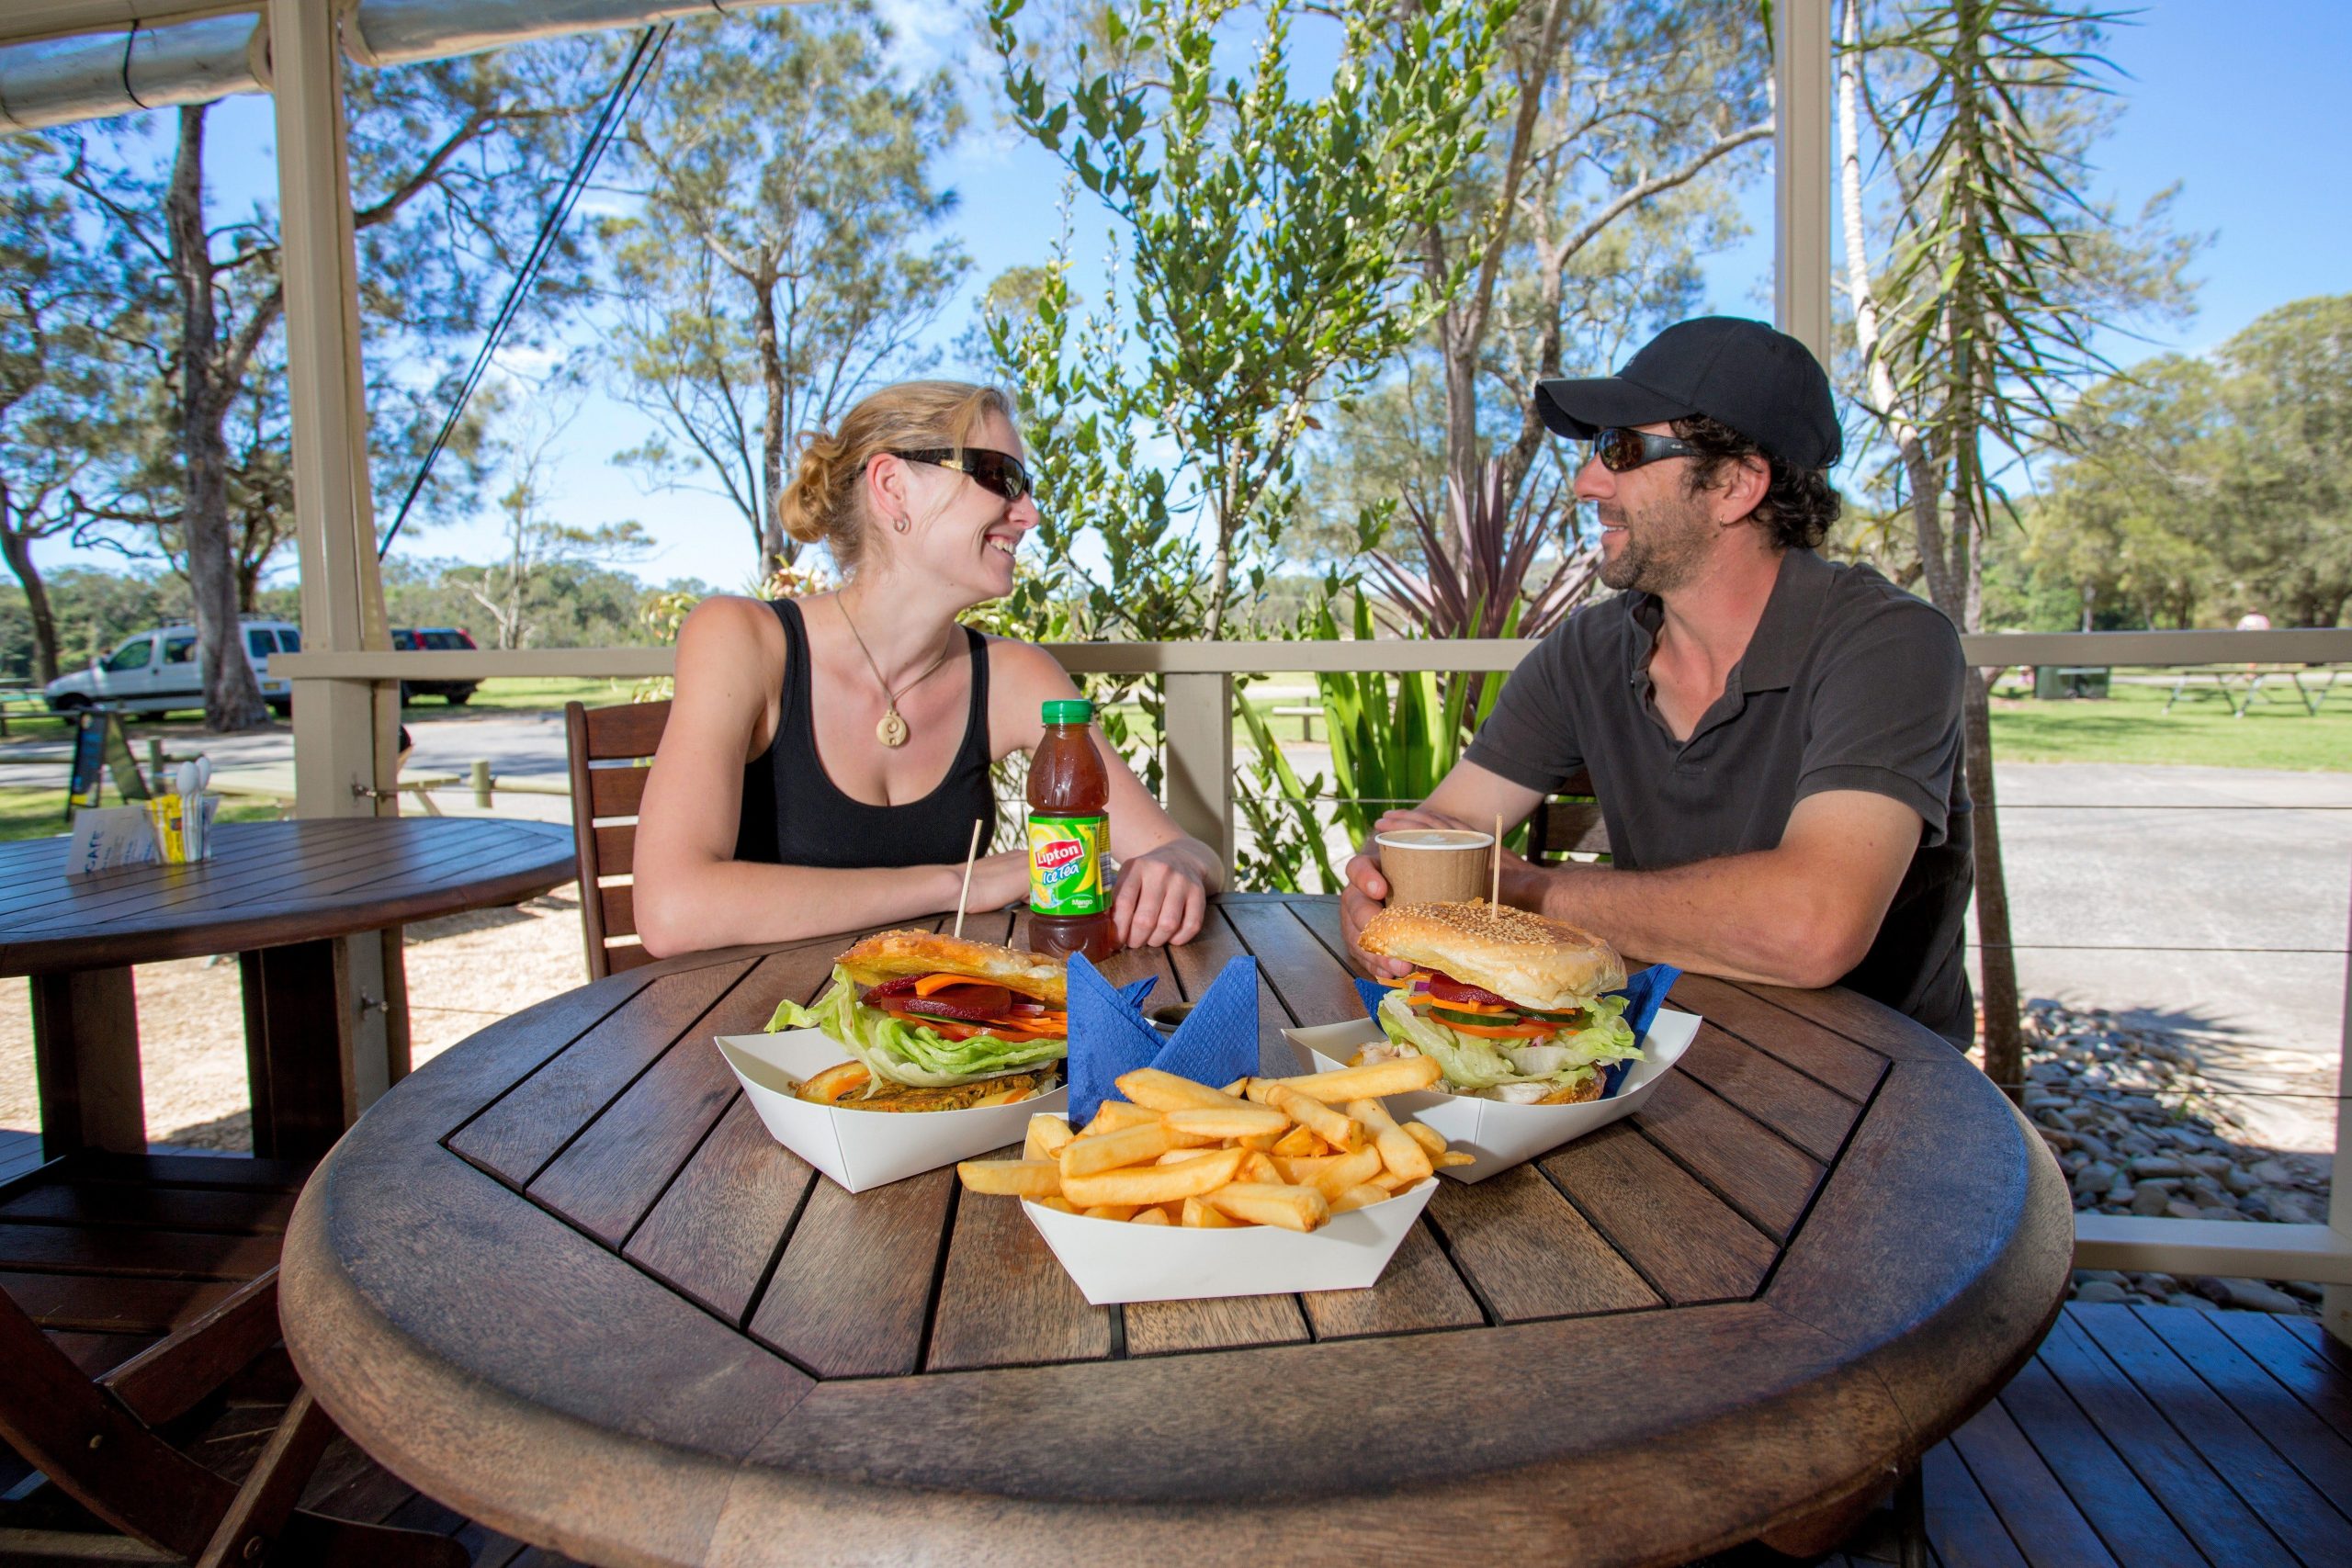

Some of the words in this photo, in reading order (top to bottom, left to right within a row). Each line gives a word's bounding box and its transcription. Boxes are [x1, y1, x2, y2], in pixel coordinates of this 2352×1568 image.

[1036, 845, 1079, 865] Lipton
[1043, 872, 1058, 885] Ice
[1057, 863, 1080, 879] Tea
